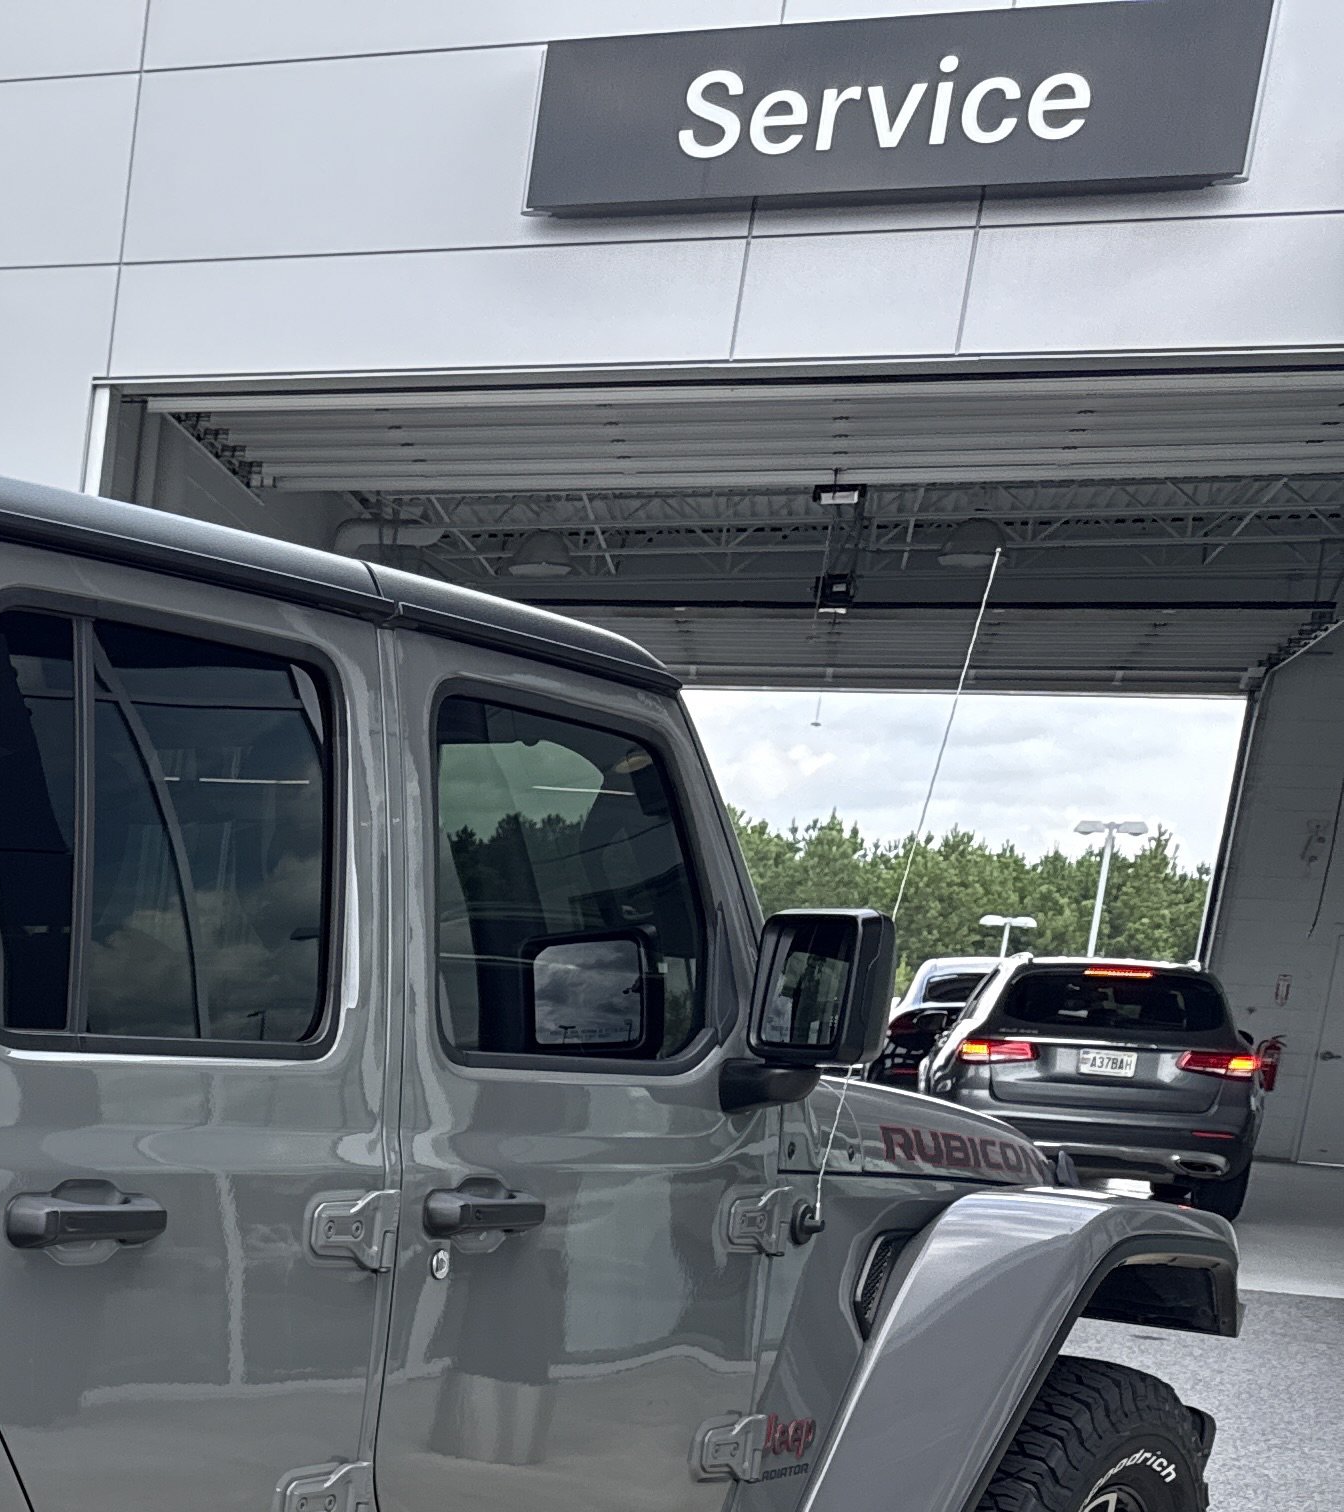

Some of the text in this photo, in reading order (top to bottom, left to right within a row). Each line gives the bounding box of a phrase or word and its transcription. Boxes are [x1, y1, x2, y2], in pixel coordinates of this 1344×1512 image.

[677, 54, 1092, 159] Service
[879, 1124, 1045, 1185] RUBICON
[761, 1462, 810, 1482] ADIATOR
